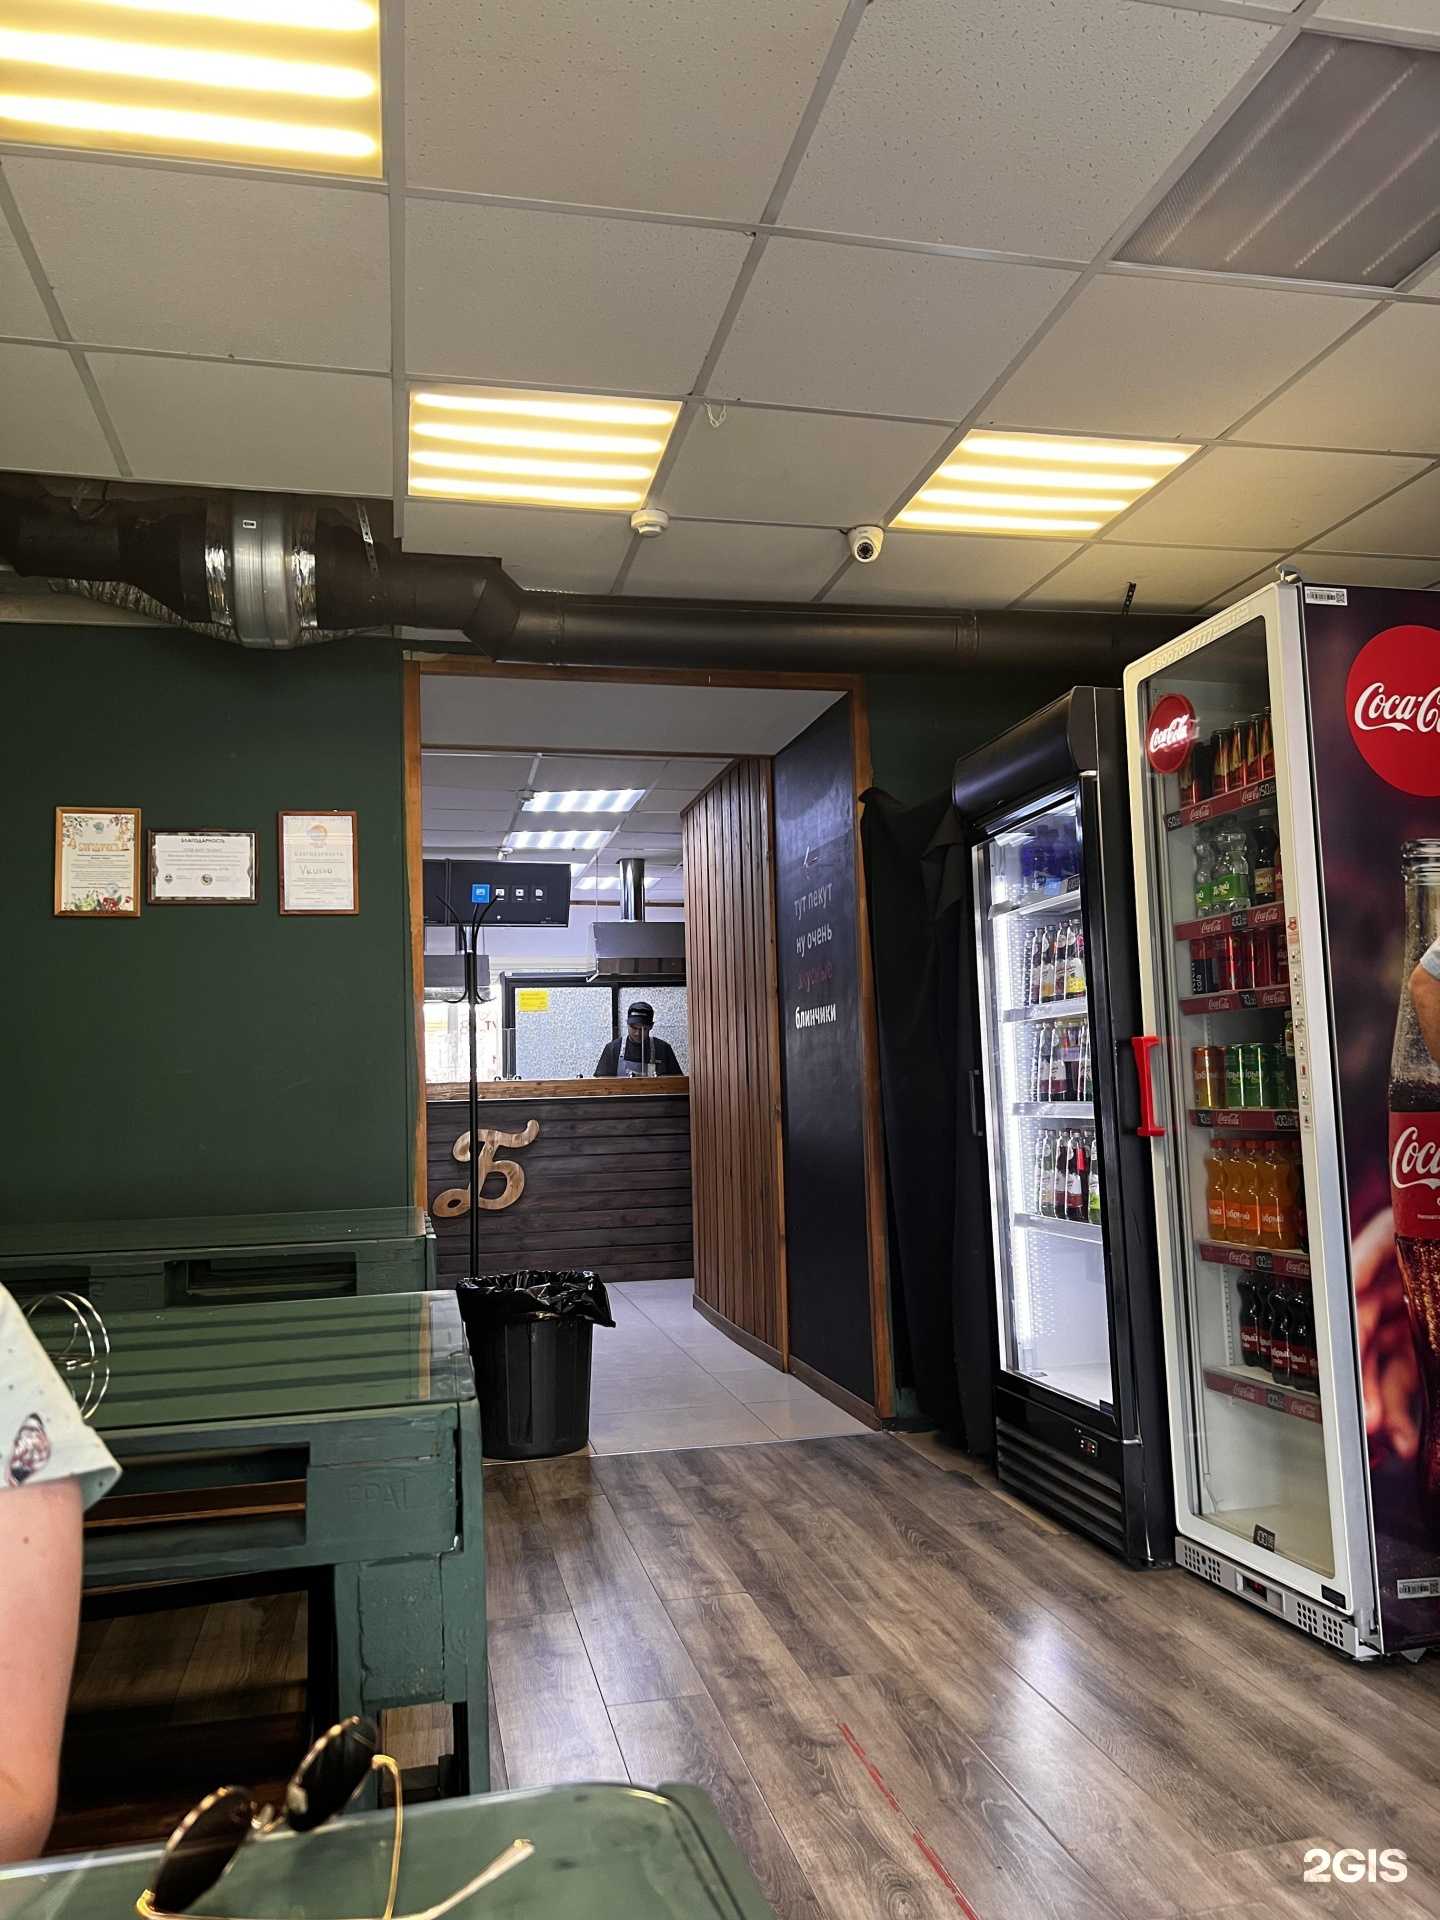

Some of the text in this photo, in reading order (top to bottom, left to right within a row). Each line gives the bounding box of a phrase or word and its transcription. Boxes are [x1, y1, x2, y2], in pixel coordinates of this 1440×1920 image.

[794, 882, 833, 921] тут пекут
[796, 922, 833, 958] ну очень
[795, 1002, 837, 1030] блинчики
